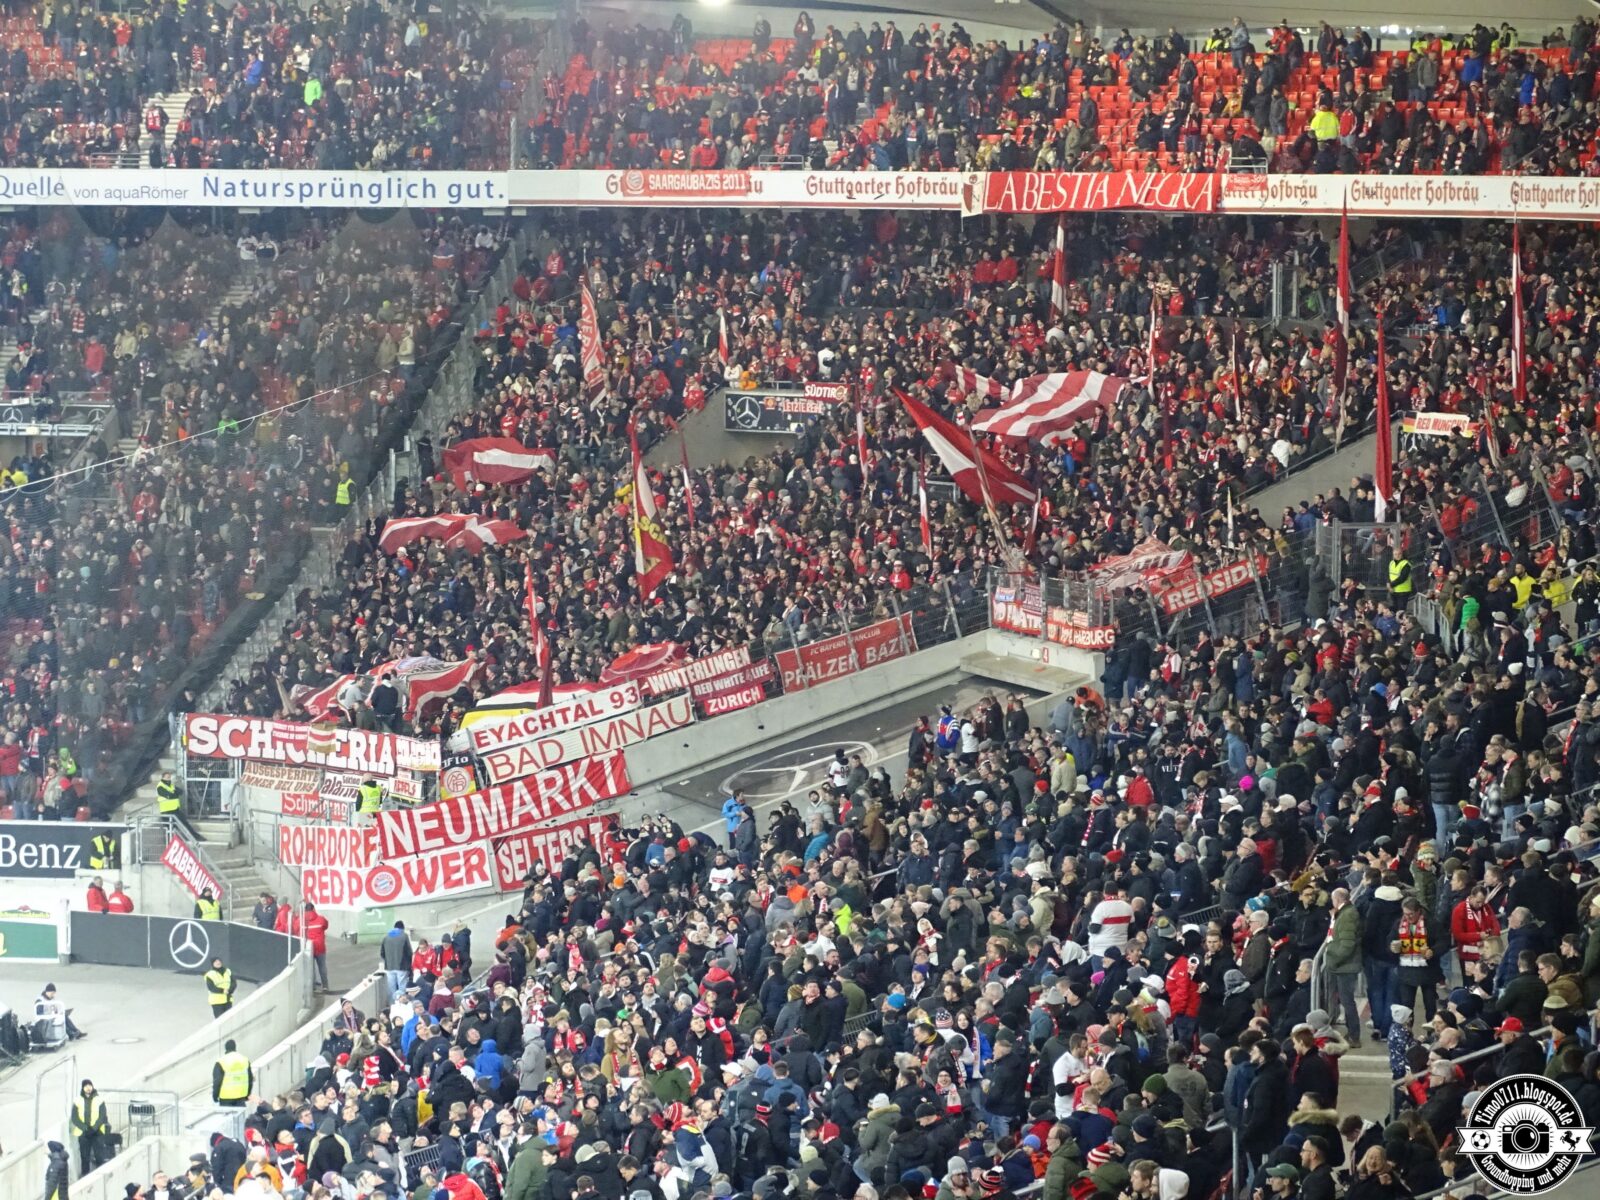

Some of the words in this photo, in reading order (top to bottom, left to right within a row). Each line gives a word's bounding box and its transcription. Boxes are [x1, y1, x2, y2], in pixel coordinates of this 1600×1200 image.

[0, 175, 65, 199] Quelle
[74, 188, 99, 199] von
[104, 184, 189, 201] aquaRömer
[203, 173, 437, 204] Natursprünglich
[448, 178, 505, 204] gut.
[649, 173, 720, 191] SAARGAUBAZIS
[722, 173, 746, 190] 2011
[806, 174, 891, 200] Stuttgarter
[895, 172, 959, 199] Hofbräu
[1021, 172, 1110, 211] BESTIA
[1114, 170, 1214, 211] NEGRA
[1351, 178, 1422, 206] Stuttgarter
[1425, 178, 1479, 206] Hofbräu
[1511, 181, 1576, 208] Stuttgarter
[648, 646, 751, 694] WINTERLINGEN
[713, 672, 745, 691] WHITE
[707, 686, 761, 713] ZURICH
[474, 699, 604, 749] EYACHTAL
[609, 686, 639, 709] 93
[488, 738, 564, 781] BAD
[579, 696, 692, 752] IMNAU
[245, 764, 319, 782] AUSGESPERRTE
[381, 749, 618, 857] NEUMARKT
[0, 834, 80, 869] Benz
[280, 826, 379, 869] ROHRDORF
